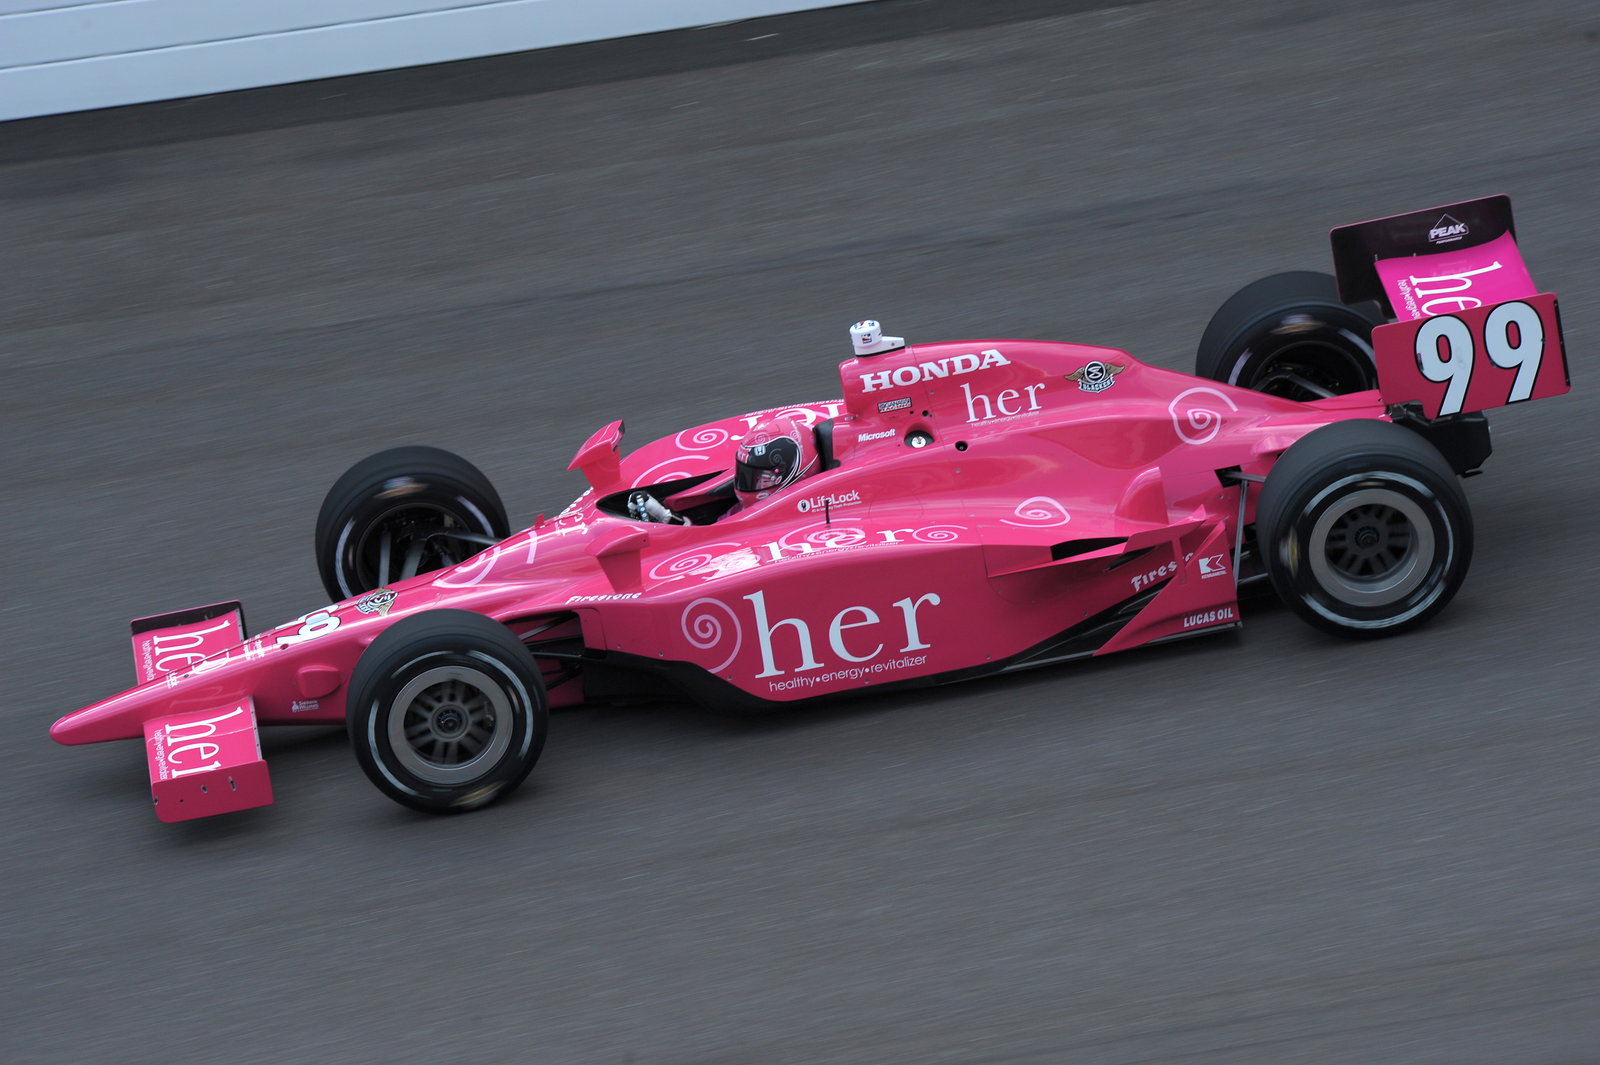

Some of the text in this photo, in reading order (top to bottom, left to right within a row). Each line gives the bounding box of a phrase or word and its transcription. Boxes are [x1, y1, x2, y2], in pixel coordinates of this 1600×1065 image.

[1429, 222, 1466, 240] PEAK
[859, 349, 1011, 393] HONDA
[1414, 300, 1545, 418] 99
[960, 382, 1046, 424] her
[858, 428, 896, 442] Microsoft
[809, 490, 861, 508] LifeLock
[762, 527, 915, 563] her
[565, 591, 642, 605] Firestone
[1183, 607, 1234, 628] LUCAS OIL
[743, 590, 941, 679] her
